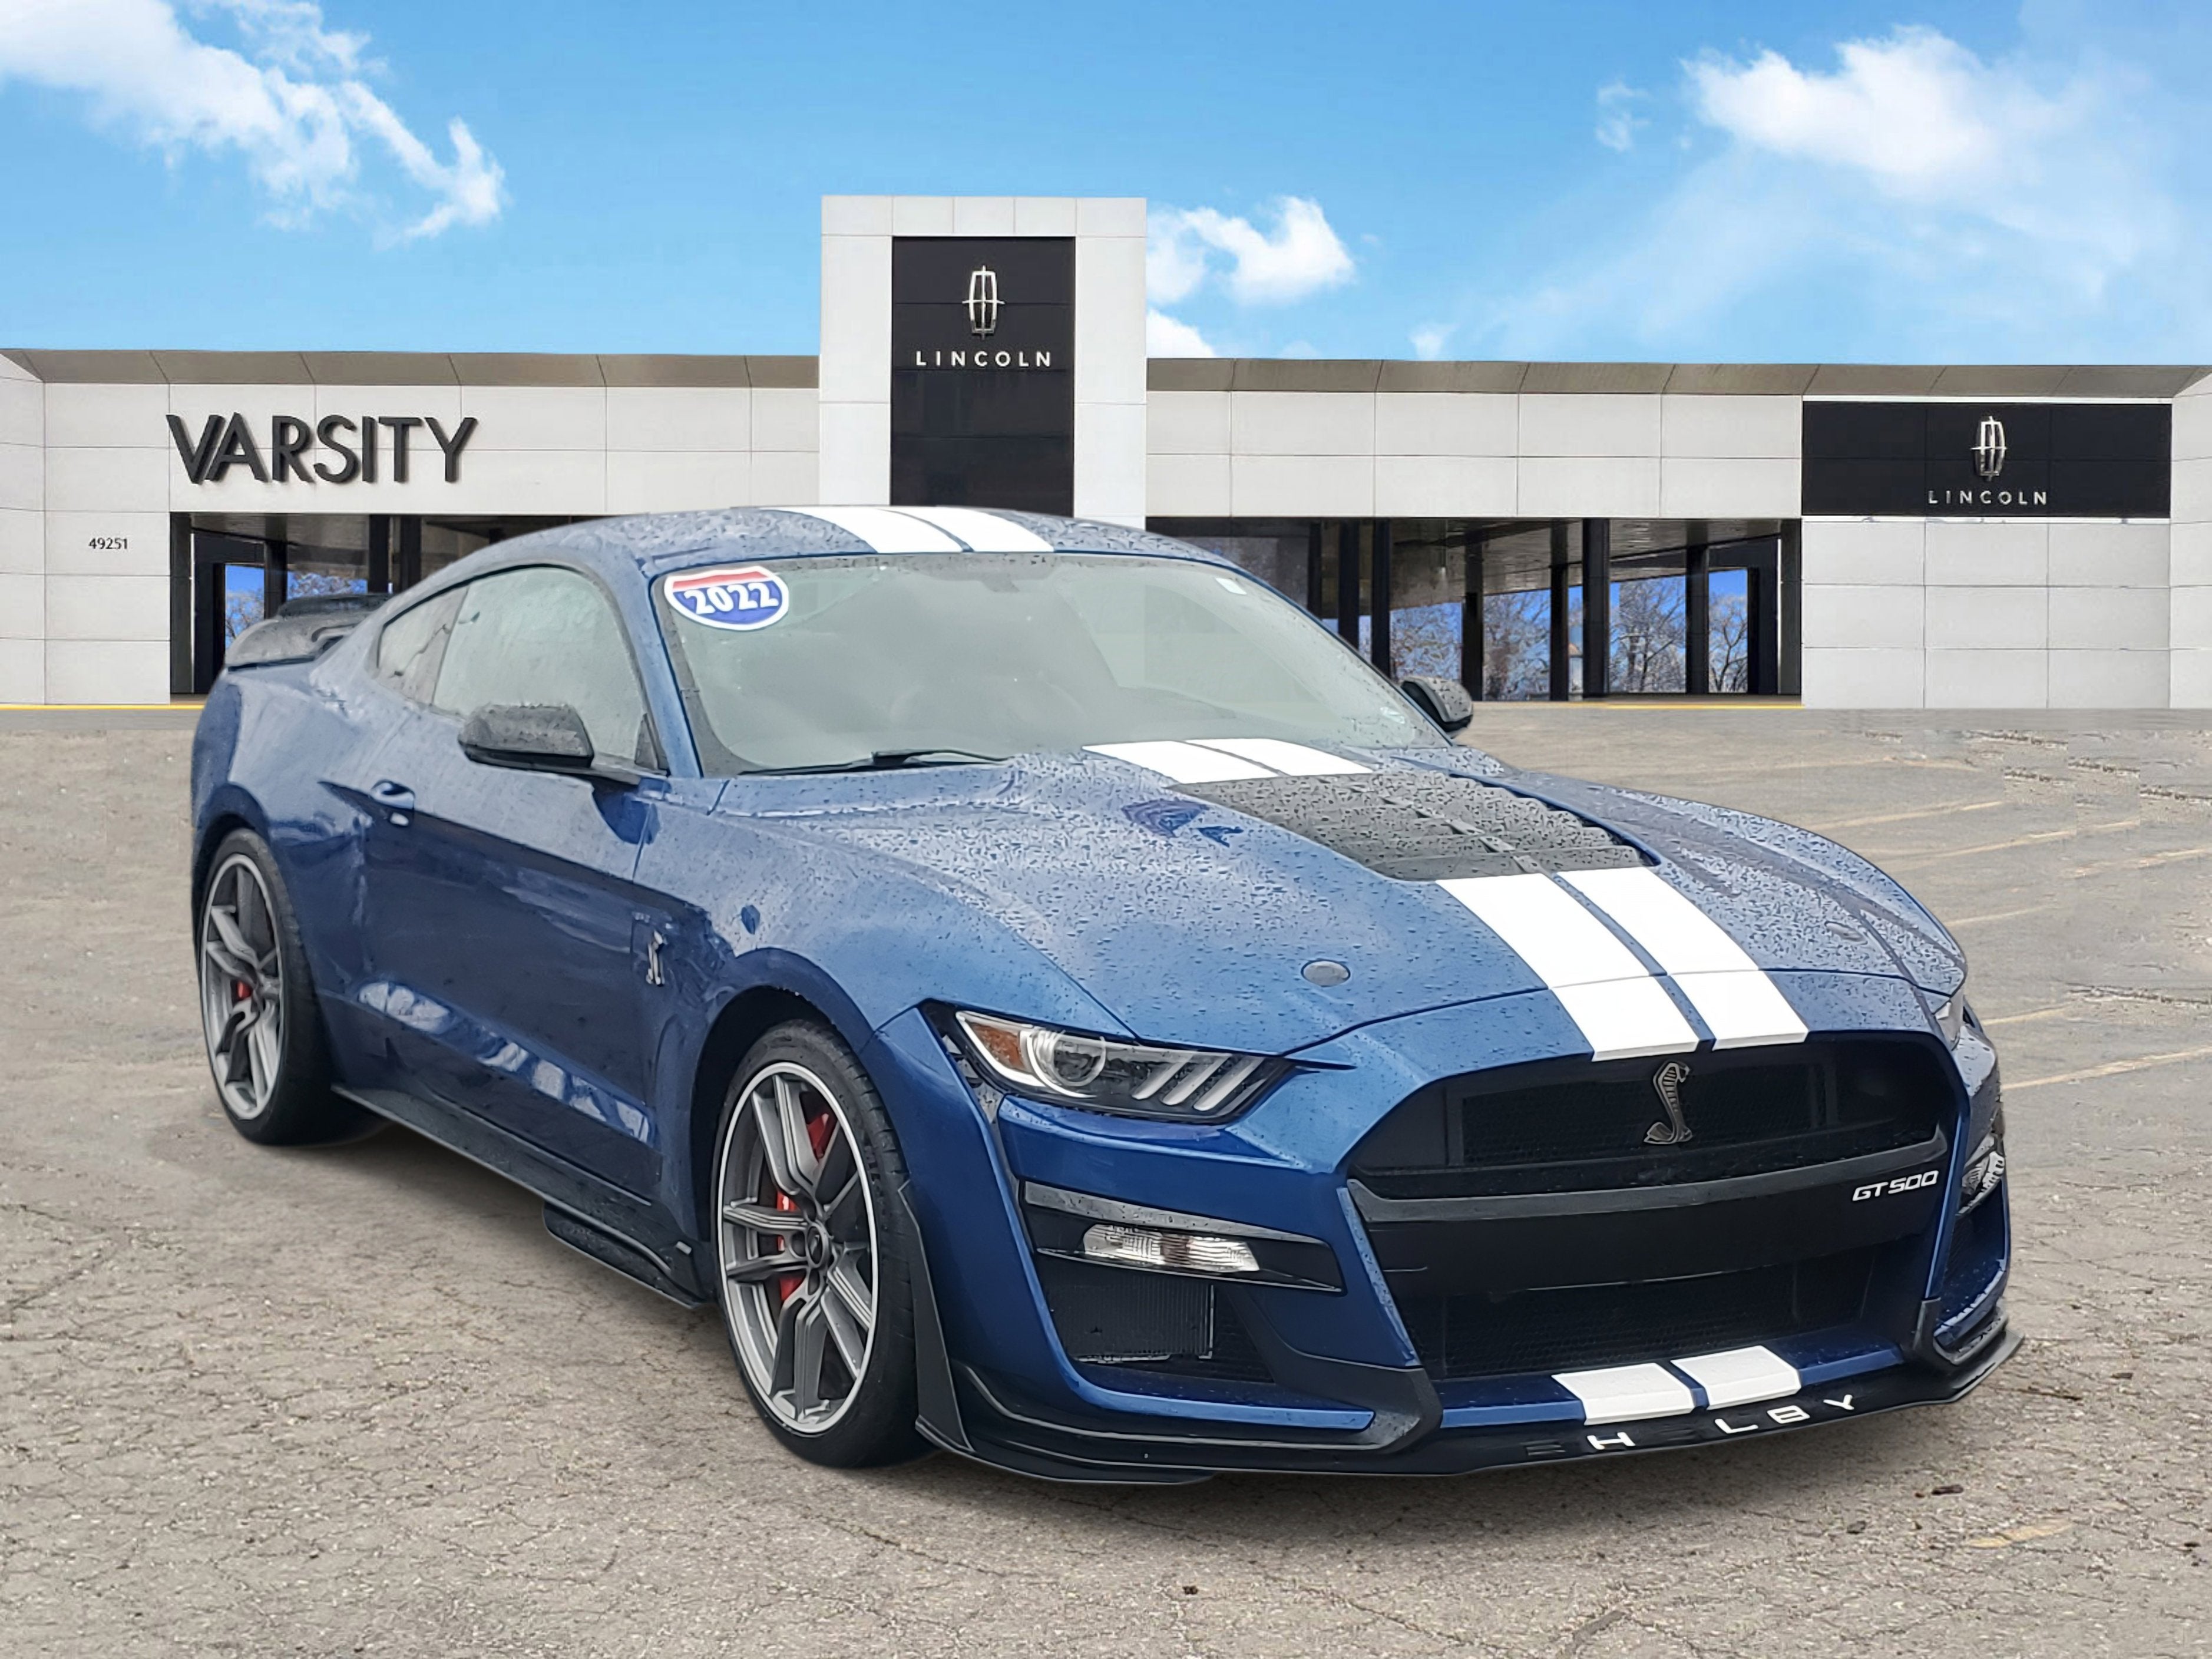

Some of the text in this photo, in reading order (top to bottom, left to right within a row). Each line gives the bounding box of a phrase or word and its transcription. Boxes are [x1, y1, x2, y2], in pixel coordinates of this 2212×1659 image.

[916, 351, 1050, 366] LINCOLN
[166, 412, 477, 484] VARSITY
[1928, 491, 2047, 505] LINCOLN
[88, 537, 128, 550] 49251
[684, 582, 779, 614] 2022
